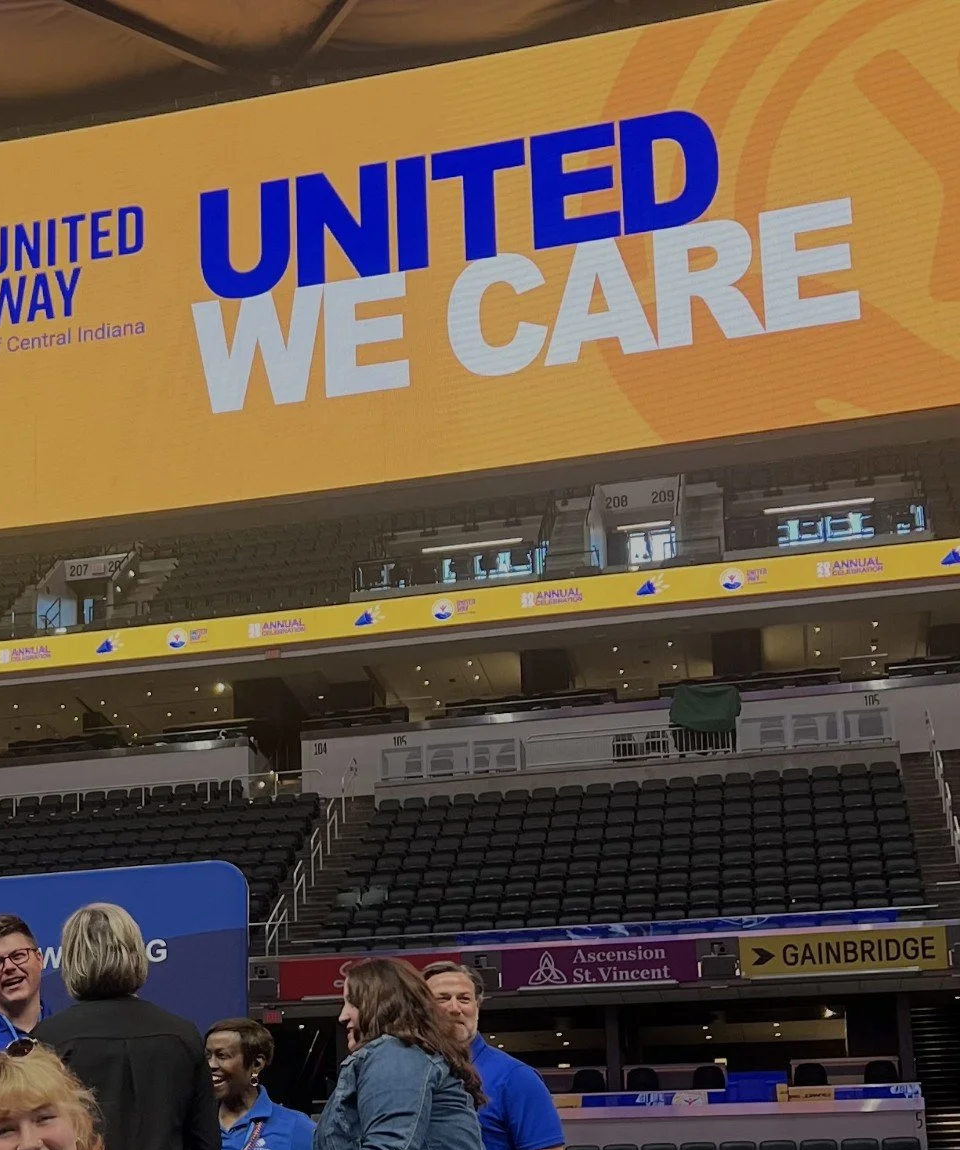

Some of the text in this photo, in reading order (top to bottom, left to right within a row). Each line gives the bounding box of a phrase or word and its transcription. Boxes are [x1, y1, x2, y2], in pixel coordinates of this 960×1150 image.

[199, 110, 719, 299] UNITED
[190, 196, 861, 414] WE CARE
[6, 327, 72, 353] Central
[77, 317, 145, 343] Indiana
[605, 489, 675, 509] 208 209
[69, 563, 89, 577] 207
[831, 565, 884, 577] CELEBRATION
[832, 557, 883, 570] ANNUAL
[536, 588, 581, 600] ANNUAL
[262, 618, 304, 630] ANNUAL
[11, 645, 52, 656] ANNUAL
[313, 742, 327, 756] 104
[572, 945, 666, 964] Ascension
[782, 936, 936, 968] GAINBRIDGE
[572, 963, 671, 984] St. Vincent
